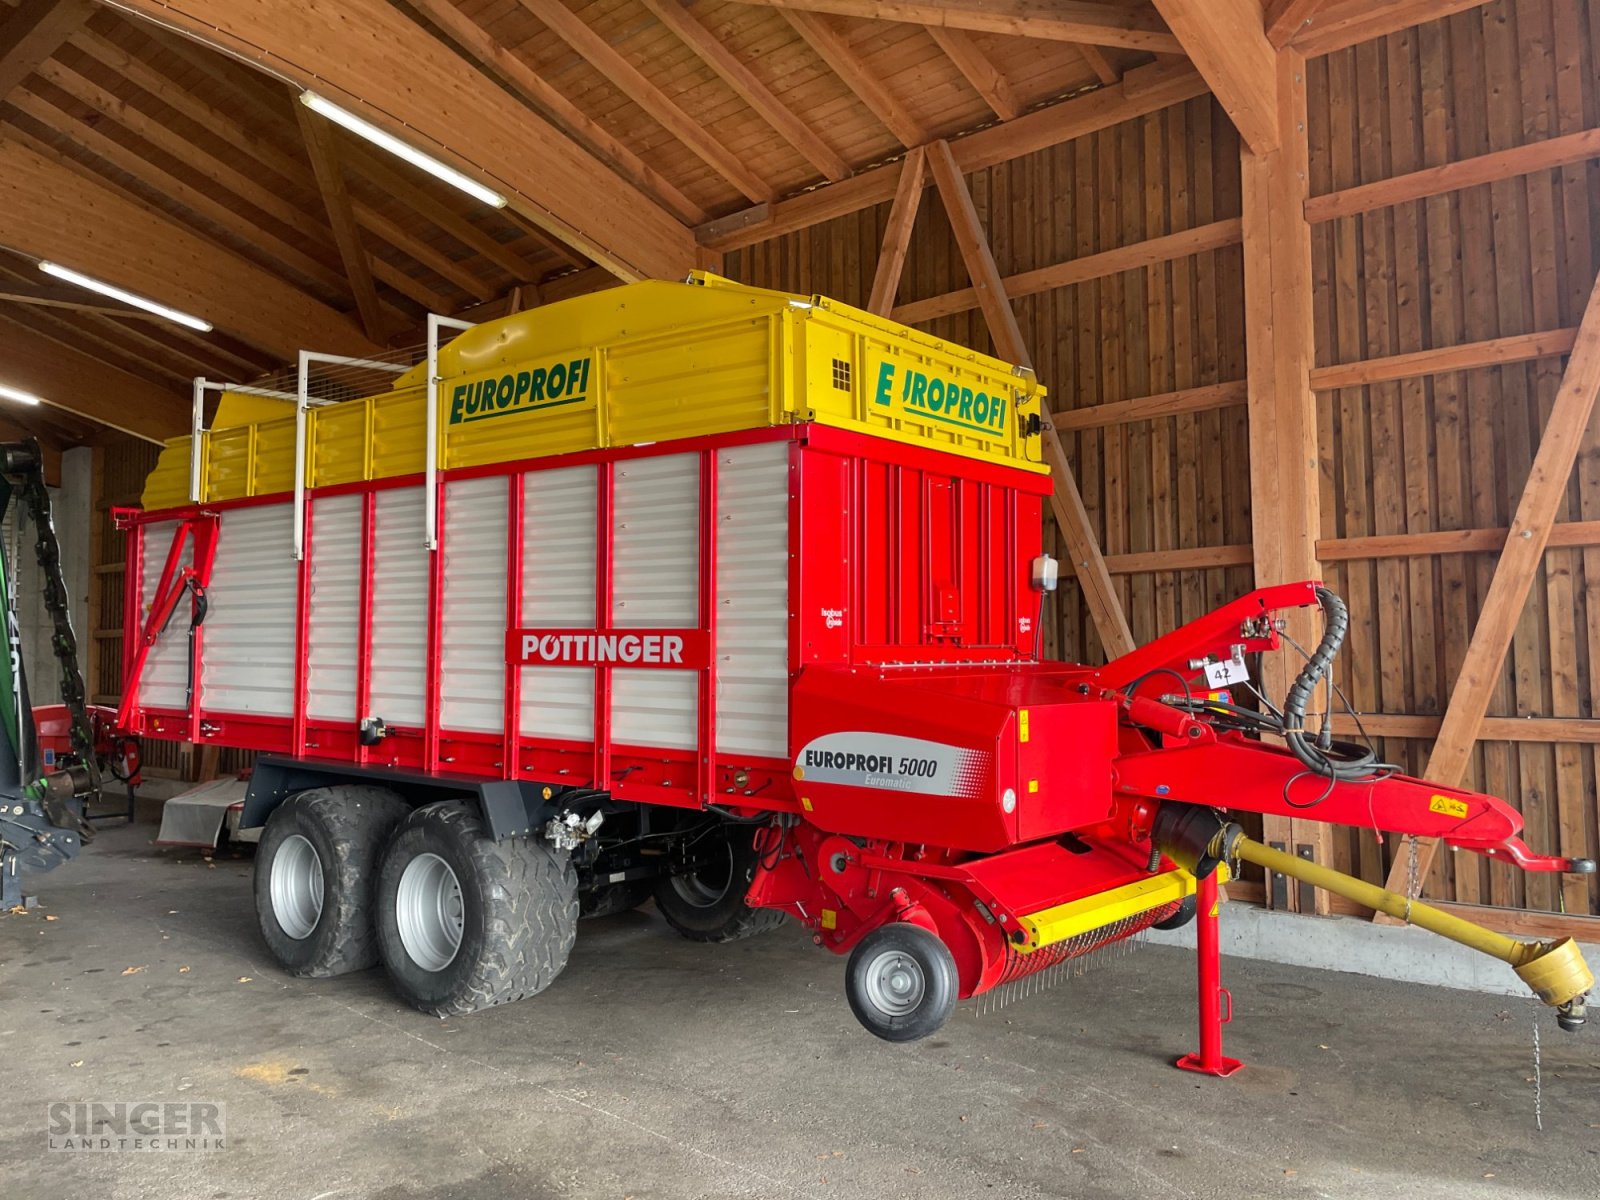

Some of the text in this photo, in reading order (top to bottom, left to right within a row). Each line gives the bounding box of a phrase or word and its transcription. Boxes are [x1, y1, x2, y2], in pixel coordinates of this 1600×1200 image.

[449, 358, 590, 425] EUROPROFI
[521, 634, 684, 664] PÖTTINGER
[1214, 668, 1231, 680] 42
[805, 749, 938, 778] EUROPROFI 5000
[865, 773, 912, 790] Euromatic
